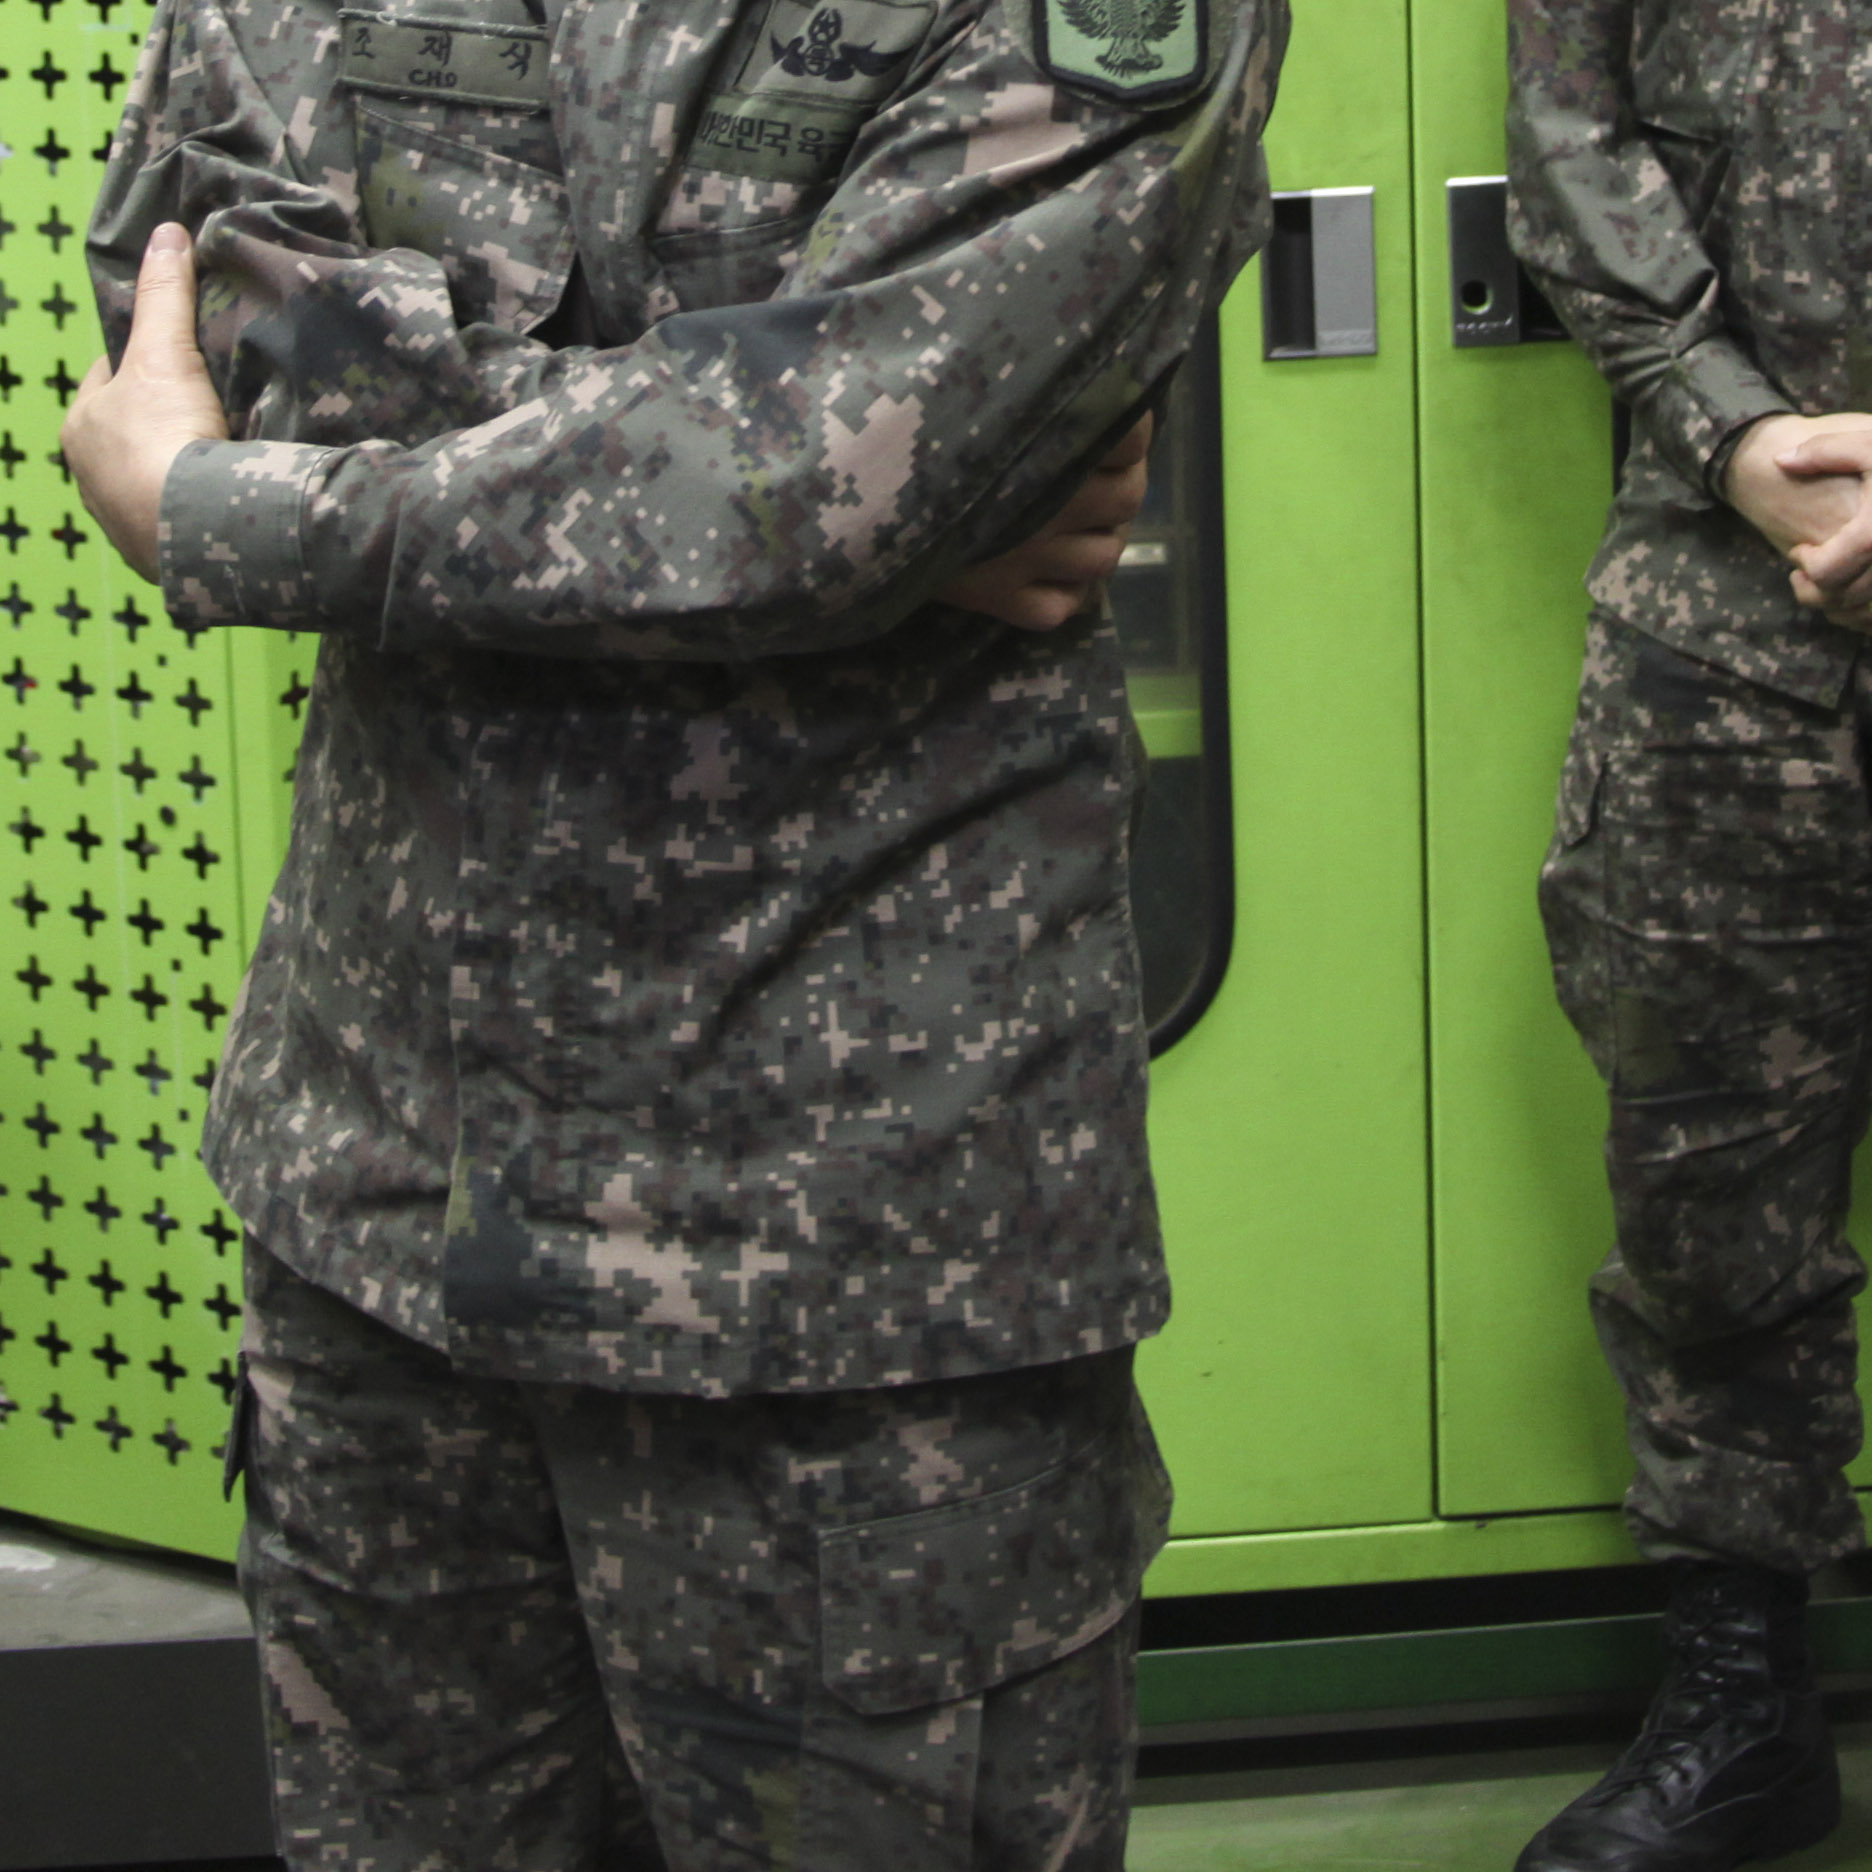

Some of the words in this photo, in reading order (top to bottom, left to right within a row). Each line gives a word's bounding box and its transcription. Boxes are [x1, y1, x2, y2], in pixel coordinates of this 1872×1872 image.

[352, 26, 376, 60] 조
[418, 30, 453, 68] 재
[499, 41, 532, 81] 식
[408, 68, 458, 89] CHO
